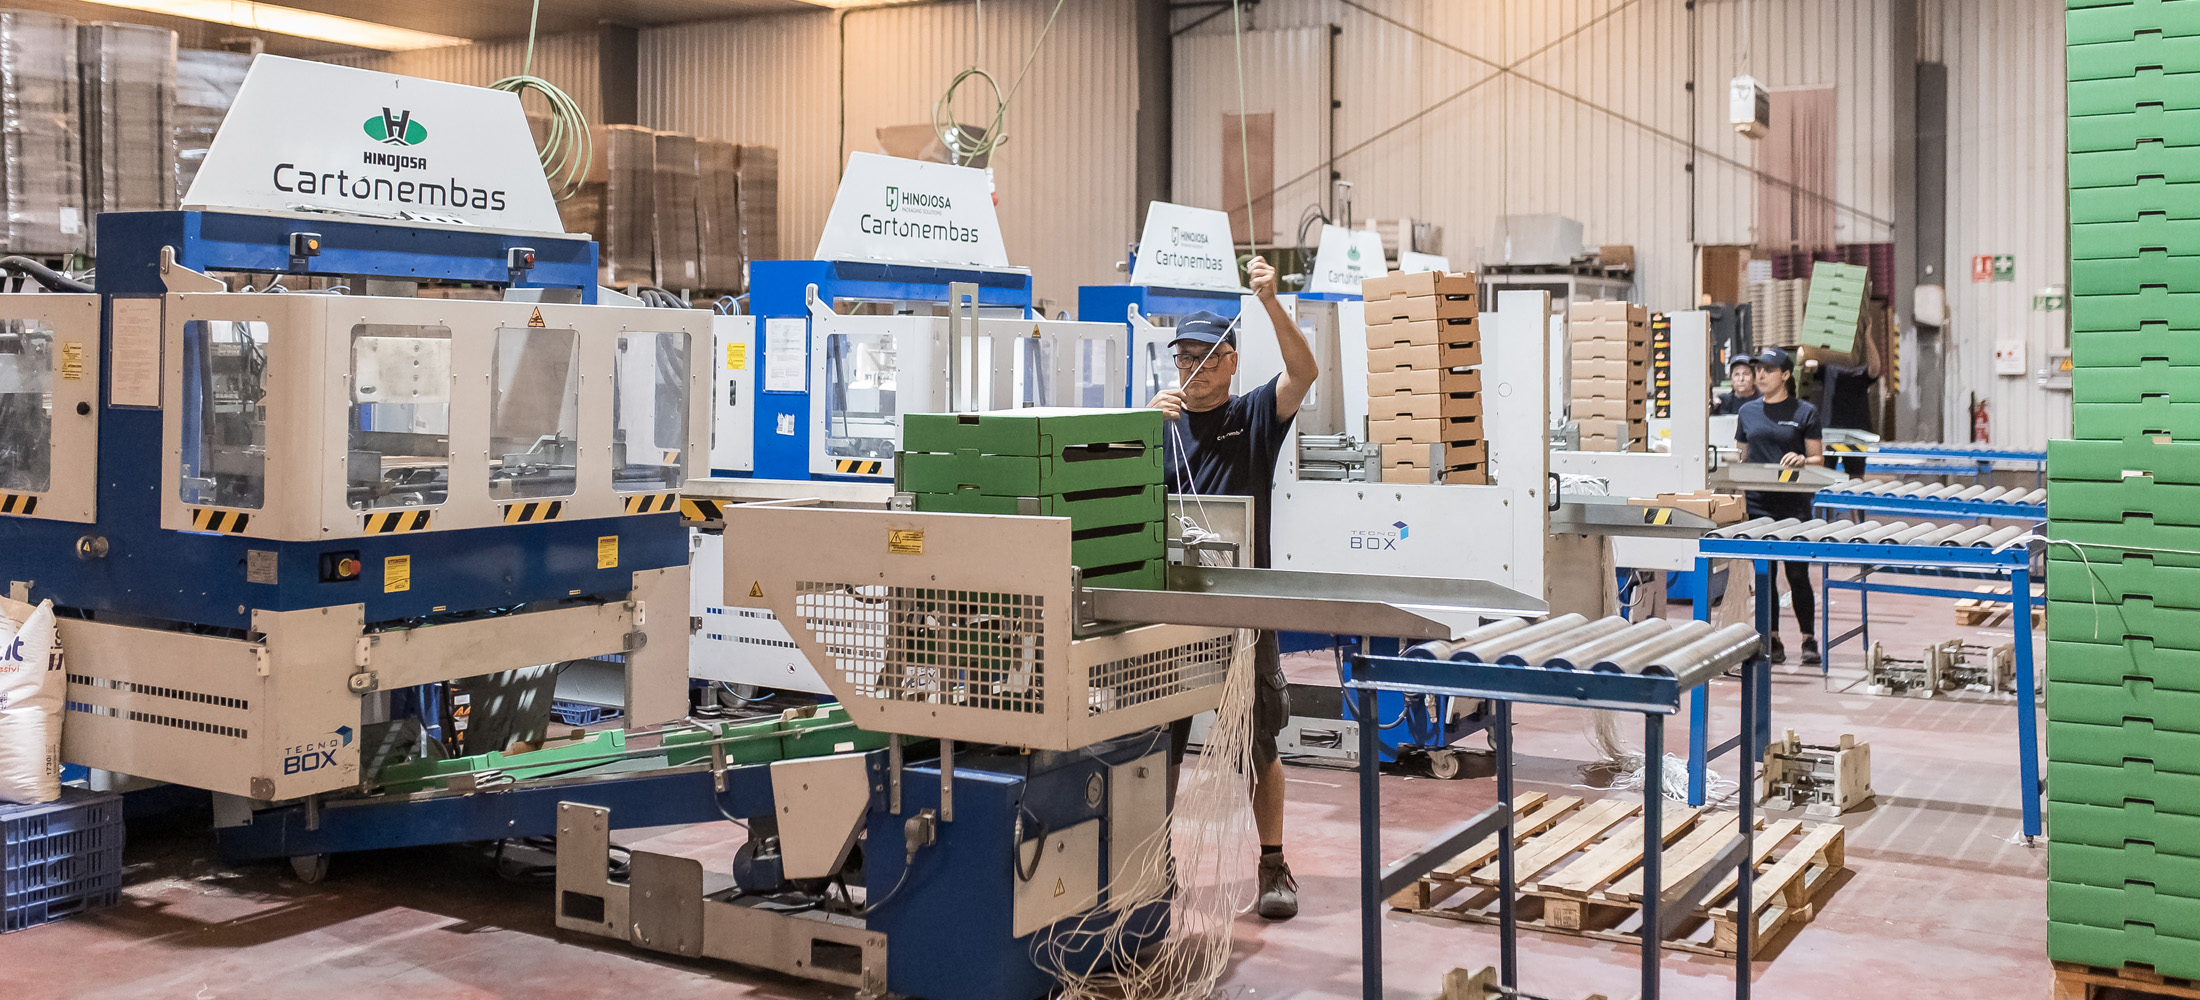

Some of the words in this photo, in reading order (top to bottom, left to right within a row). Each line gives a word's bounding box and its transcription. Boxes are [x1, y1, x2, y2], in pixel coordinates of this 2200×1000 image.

[363, 151, 427, 173] HINOJOSA
[273, 163, 506, 211] Cartonembas
[902, 192, 951, 209] HINOJOSA
[860, 214, 979, 243] Cartonembas
[1156, 249, 1223, 271] Cartonembas
[1350, 536, 1396, 551] BOX
[285, 739, 338, 755] TECNO
[284, 748, 337, 775] BOX
